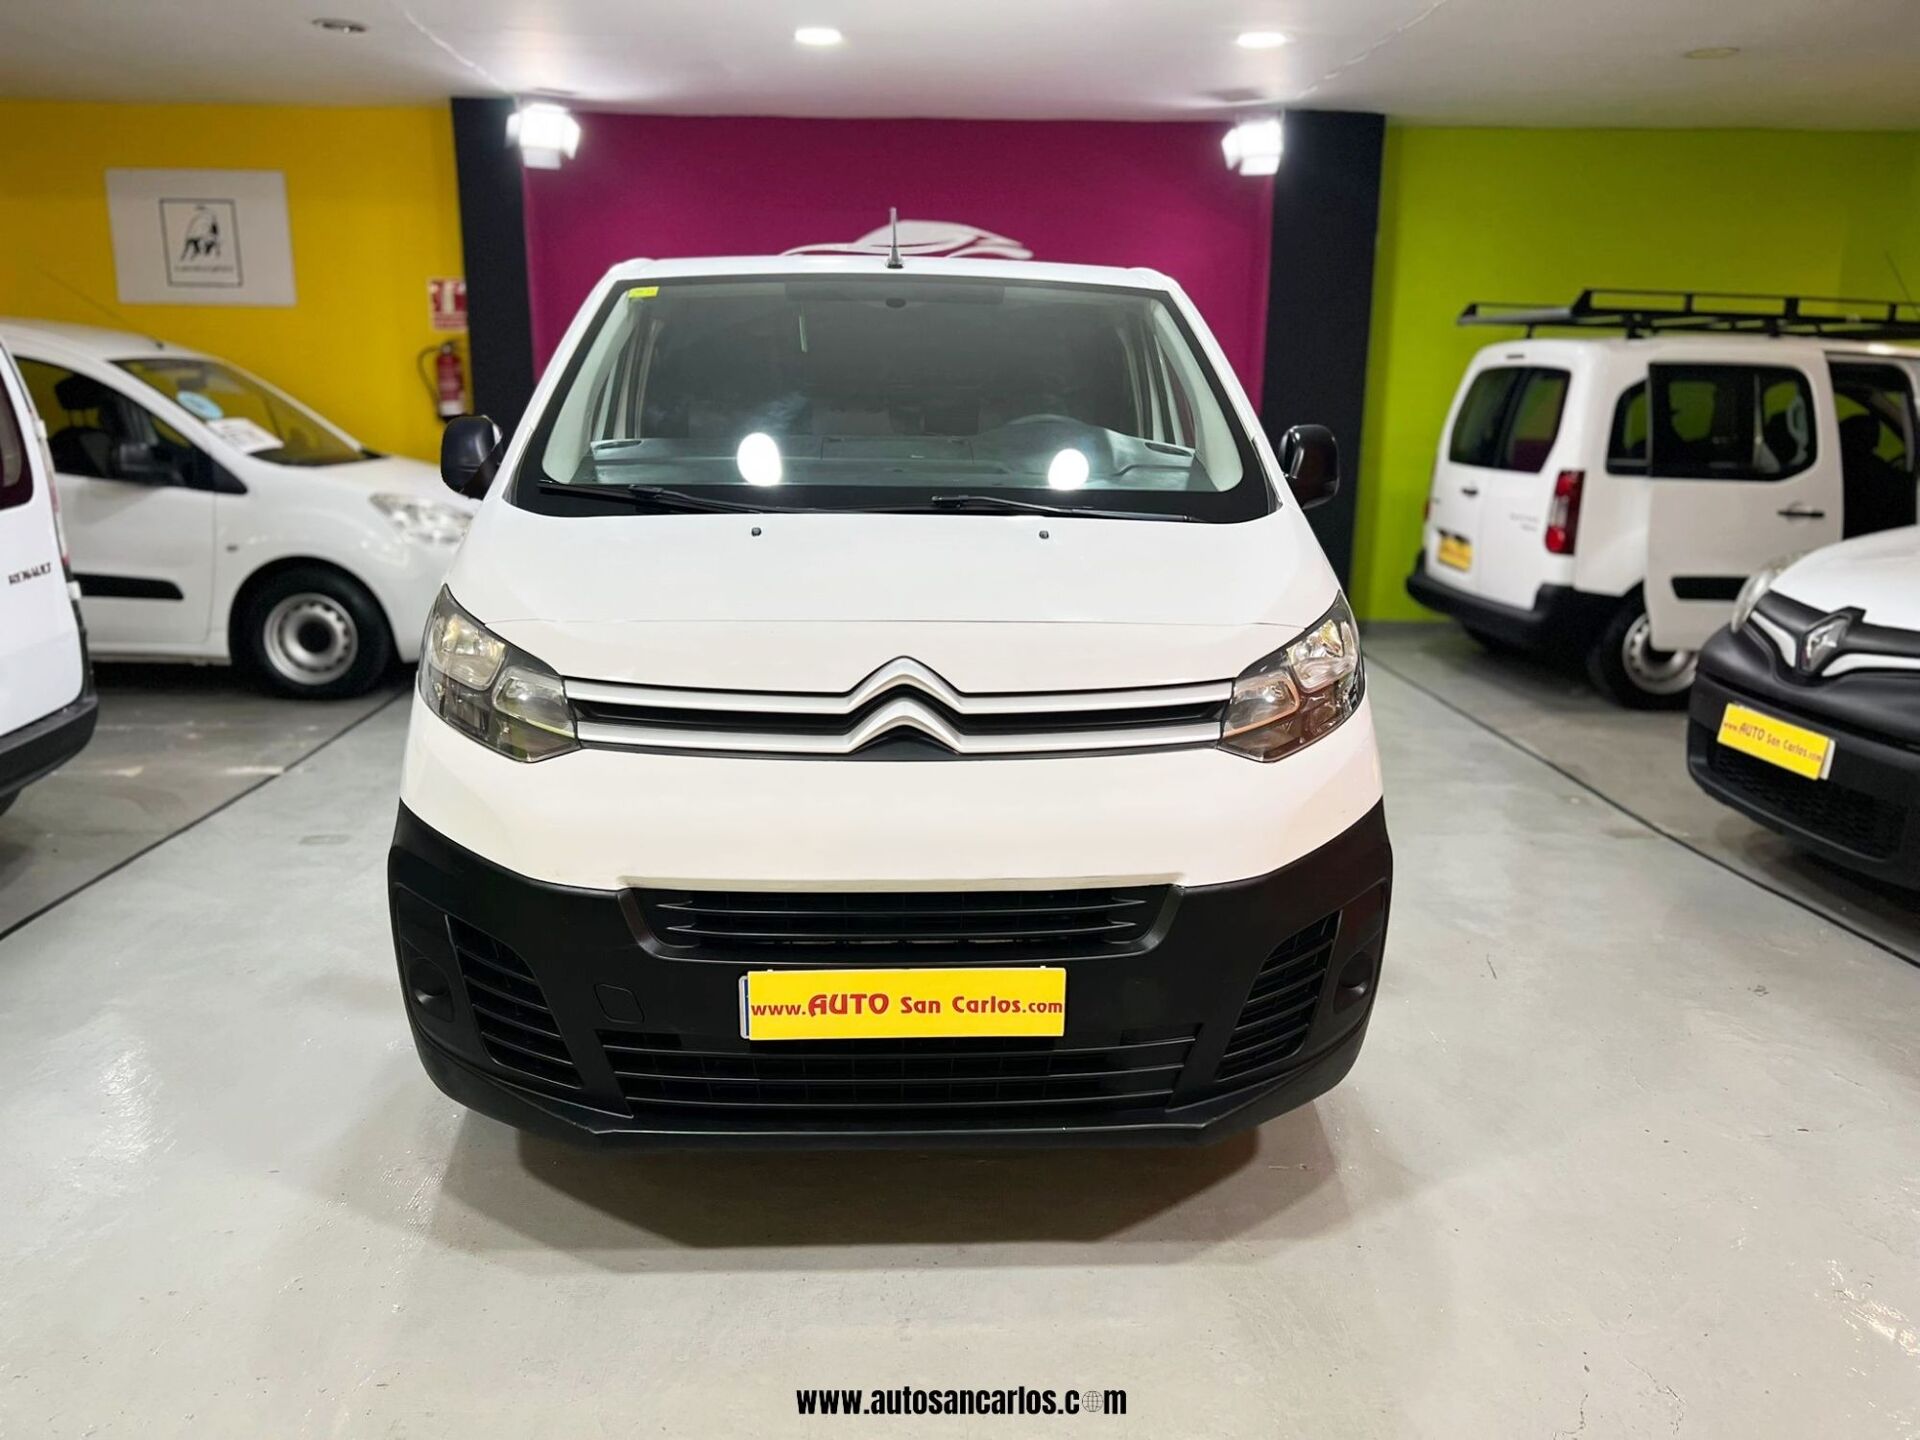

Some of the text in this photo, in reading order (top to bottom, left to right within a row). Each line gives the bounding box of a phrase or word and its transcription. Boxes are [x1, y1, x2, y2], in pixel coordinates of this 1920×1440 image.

[750, 992, 1063, 1017] www.AUTO San Carlos.com
